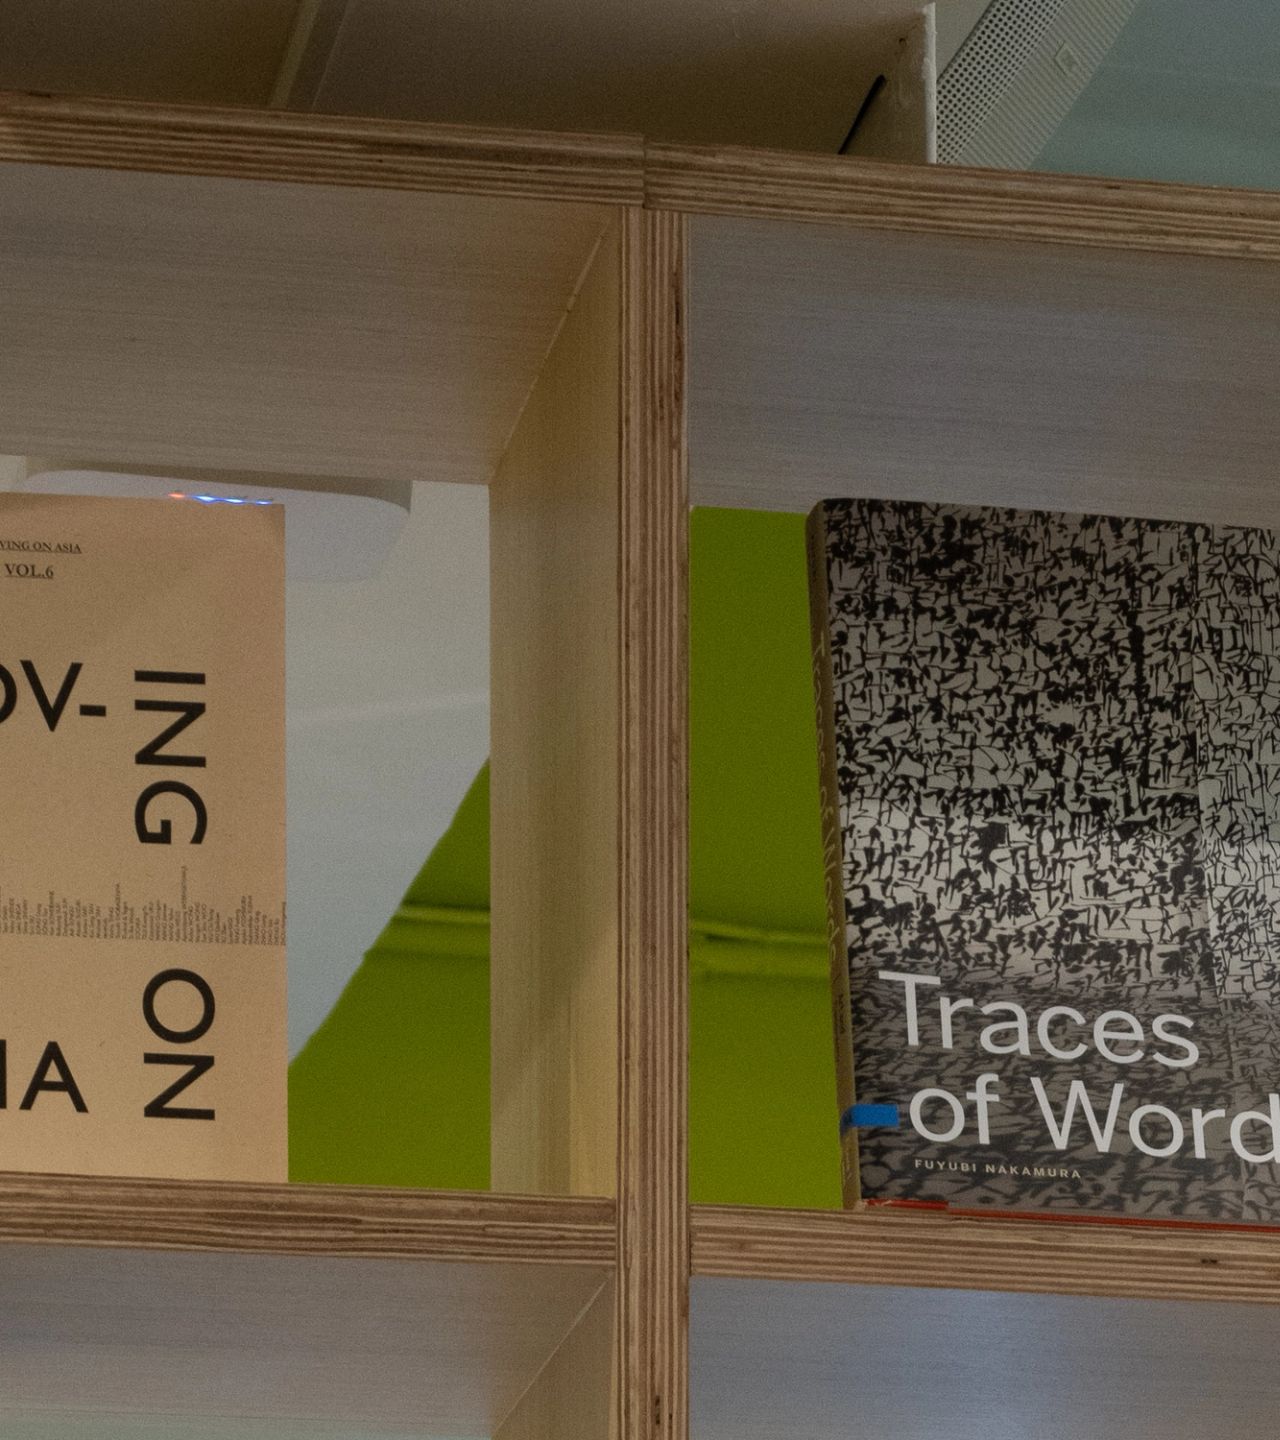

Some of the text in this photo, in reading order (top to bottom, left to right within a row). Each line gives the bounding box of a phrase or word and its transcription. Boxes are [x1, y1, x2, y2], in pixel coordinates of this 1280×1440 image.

[5, 564, 53, 579] VOL.6
[878, 970, 1201, 1069] Traces
[908, 1072, 999, 1146] of
[914, 1158, 1082, 1179] FUYUBI NAKAMURA
